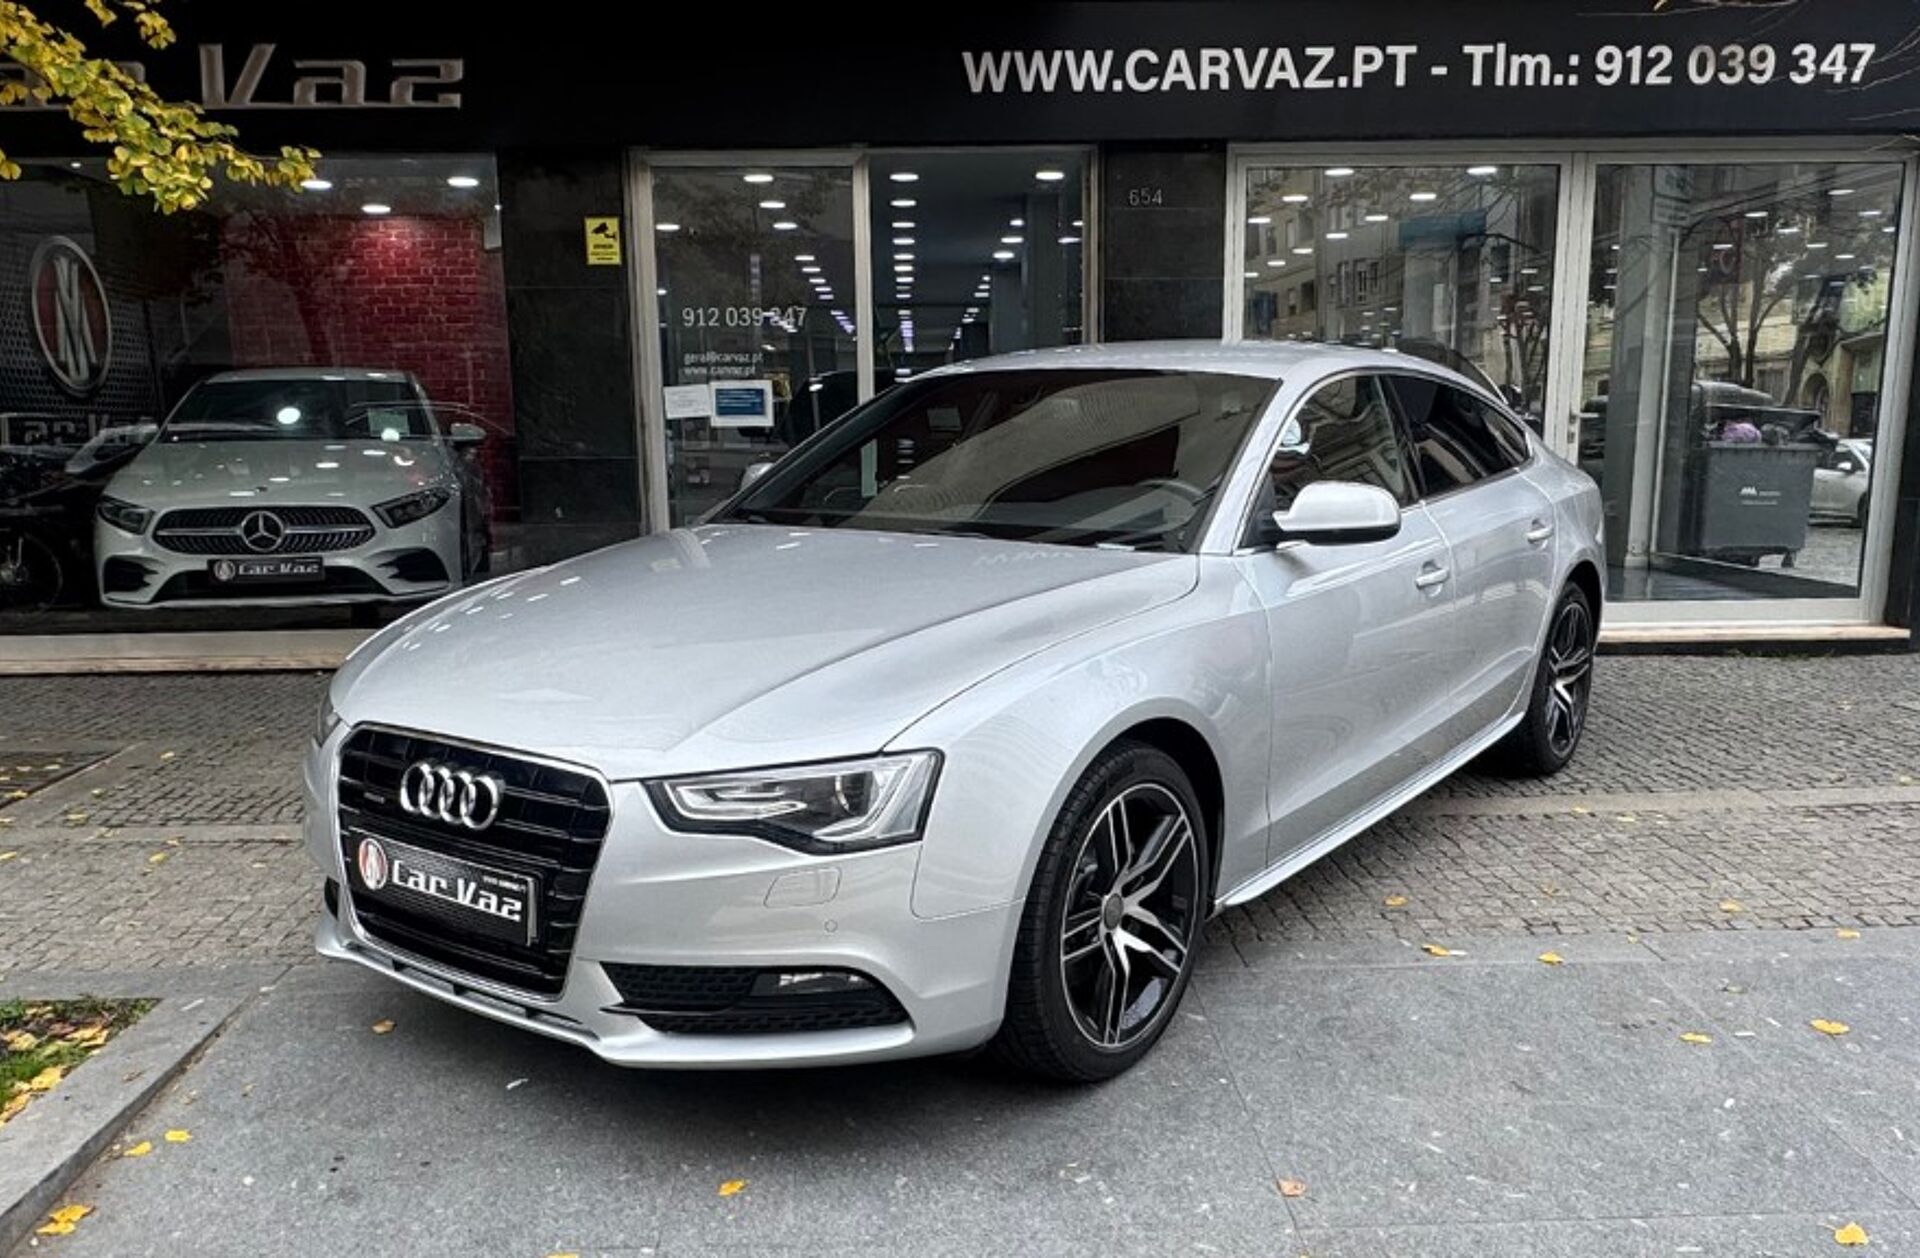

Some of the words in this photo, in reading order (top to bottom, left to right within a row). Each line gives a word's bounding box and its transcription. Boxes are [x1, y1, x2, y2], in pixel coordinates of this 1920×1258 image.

[962, 46, 1418, 93] WWW.CARVAZ.PT
[1430, 66, 1448, 76] -
[1462, 43, 1579, 87] Tlm.:
[1595, 45, 1673, 86] 912
[1687, 44, 1776, 86] 039
[1789, 42, 1877, 85] 347
[1129, 187, 1163, 206] 654
[682, 307, 720, 327] 912
[726, 307, 763, 327] 039
[391, 859, 449, 898] Car
[456, 877, 523, 923] Vaz
